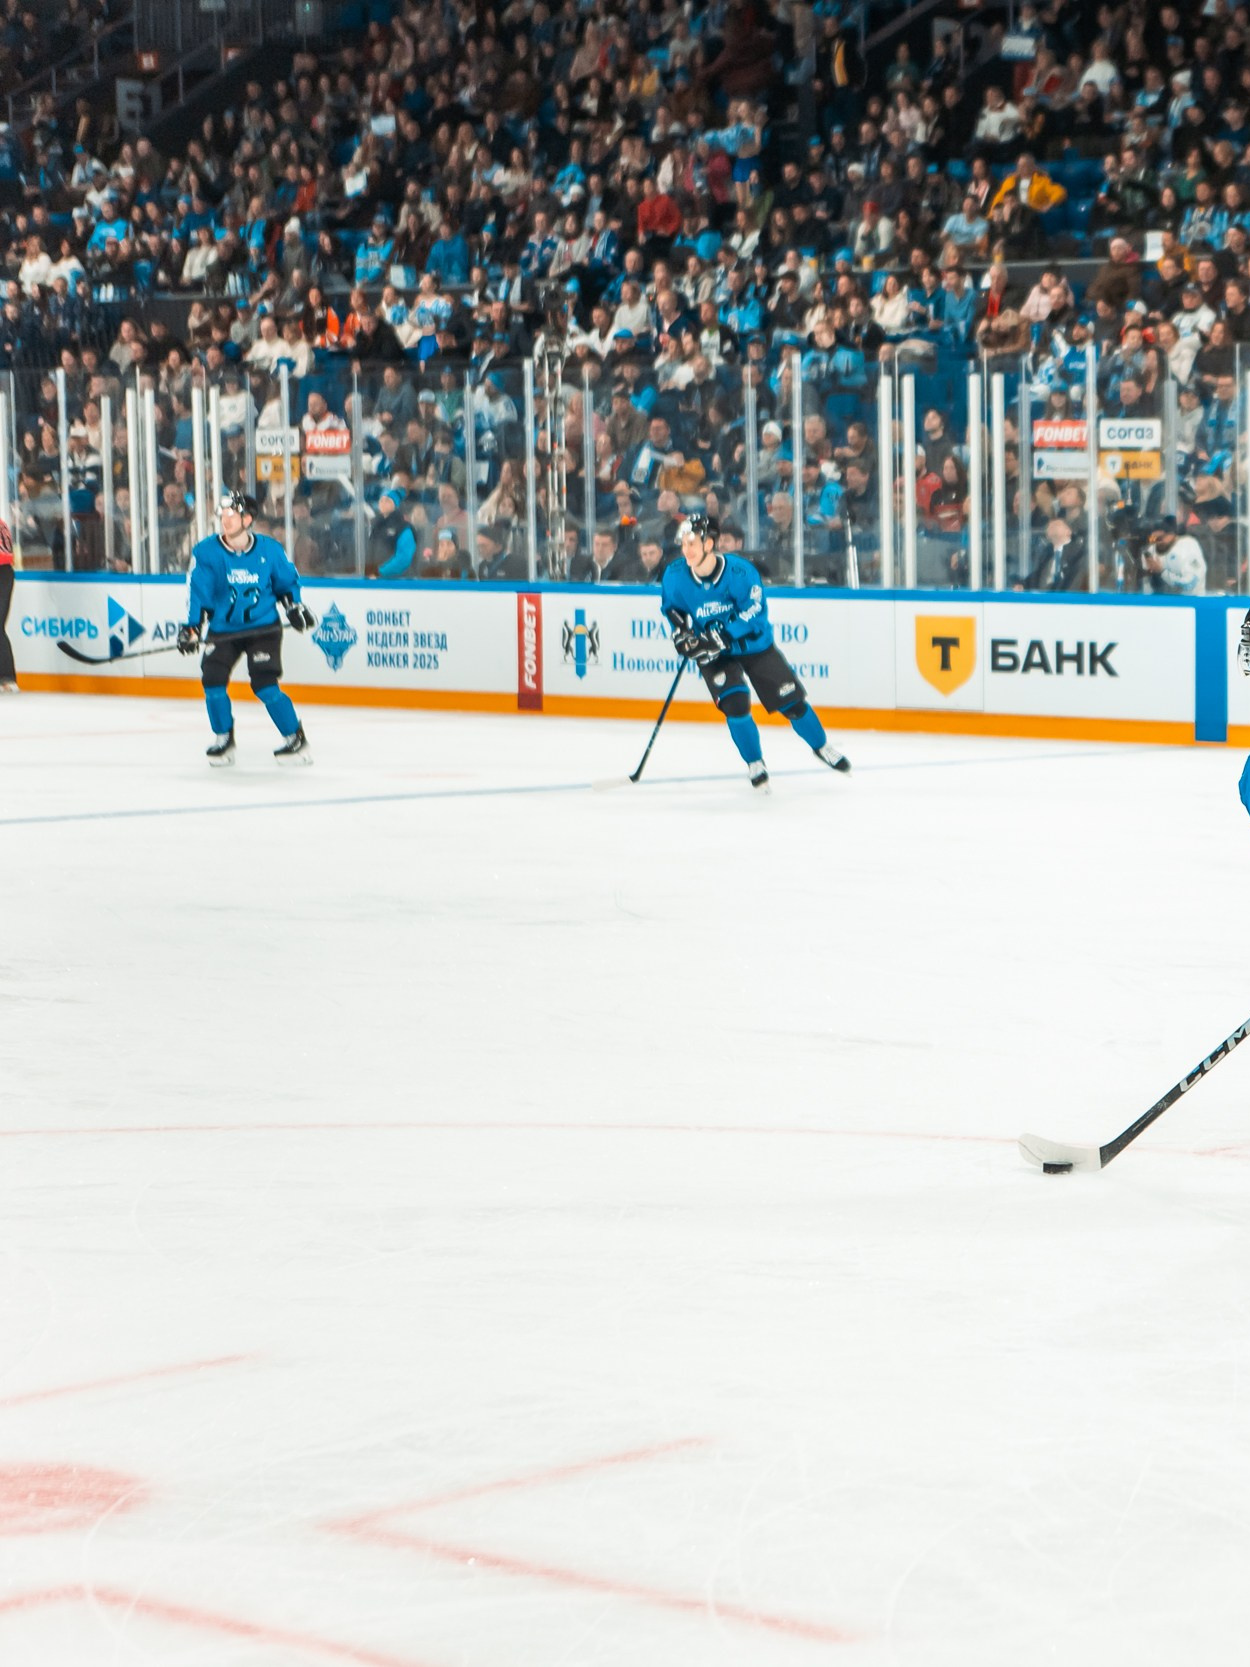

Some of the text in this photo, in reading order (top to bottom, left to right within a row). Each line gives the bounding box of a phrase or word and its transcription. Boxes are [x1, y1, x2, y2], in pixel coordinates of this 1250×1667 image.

[308, 434, 348, 449] FONBET
[1034, 427, 1088, 442] FONBET
[1107, 427, 1153, 440] согаз
[366, 609, 411, 627] ФОНБЕТ
[21, 615, 181, 641] СИБИРЬ АР
[366, 631, 448, 651] НЕДЕЛЯ ЗВЕЗД
[523, 595, 537, 690] FONBET
[367, 651, 439, 670] ХОККЕЯ 2025
[931, 636, 1120, 678] Т БАНК
